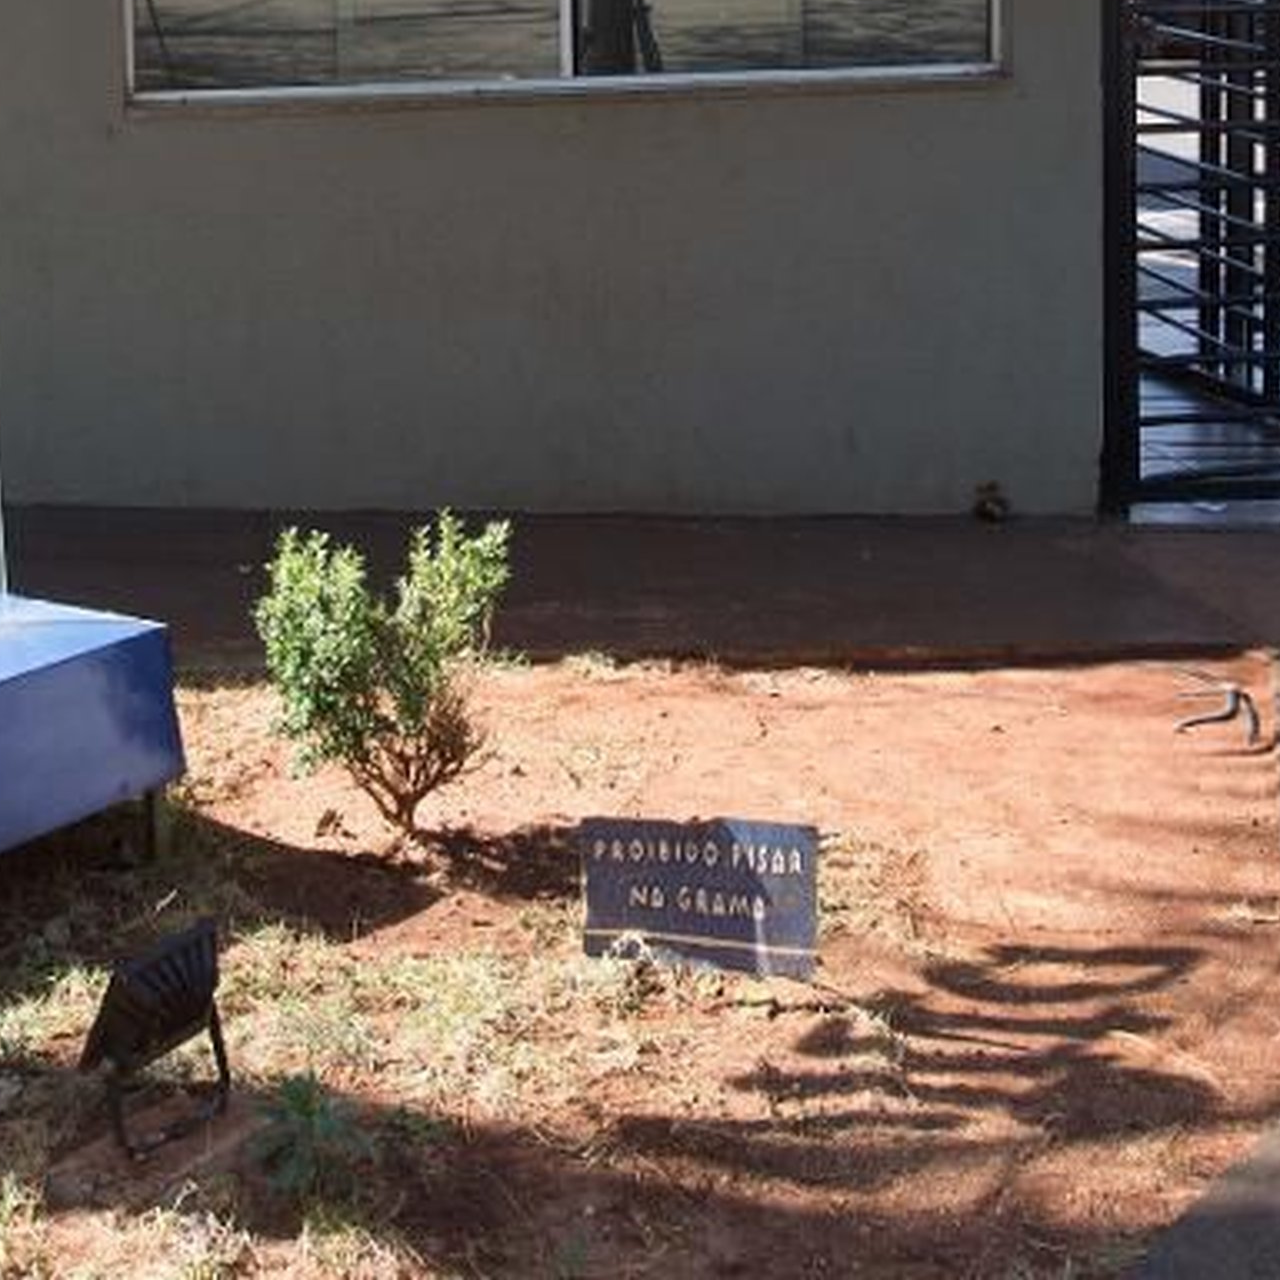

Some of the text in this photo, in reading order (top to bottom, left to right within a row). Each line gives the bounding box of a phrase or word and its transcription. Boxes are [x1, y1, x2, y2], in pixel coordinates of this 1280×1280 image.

[592, 838, 803, 875] PROIBIDO PISAR
[628, 885, 766, 921] NA GRAMA
